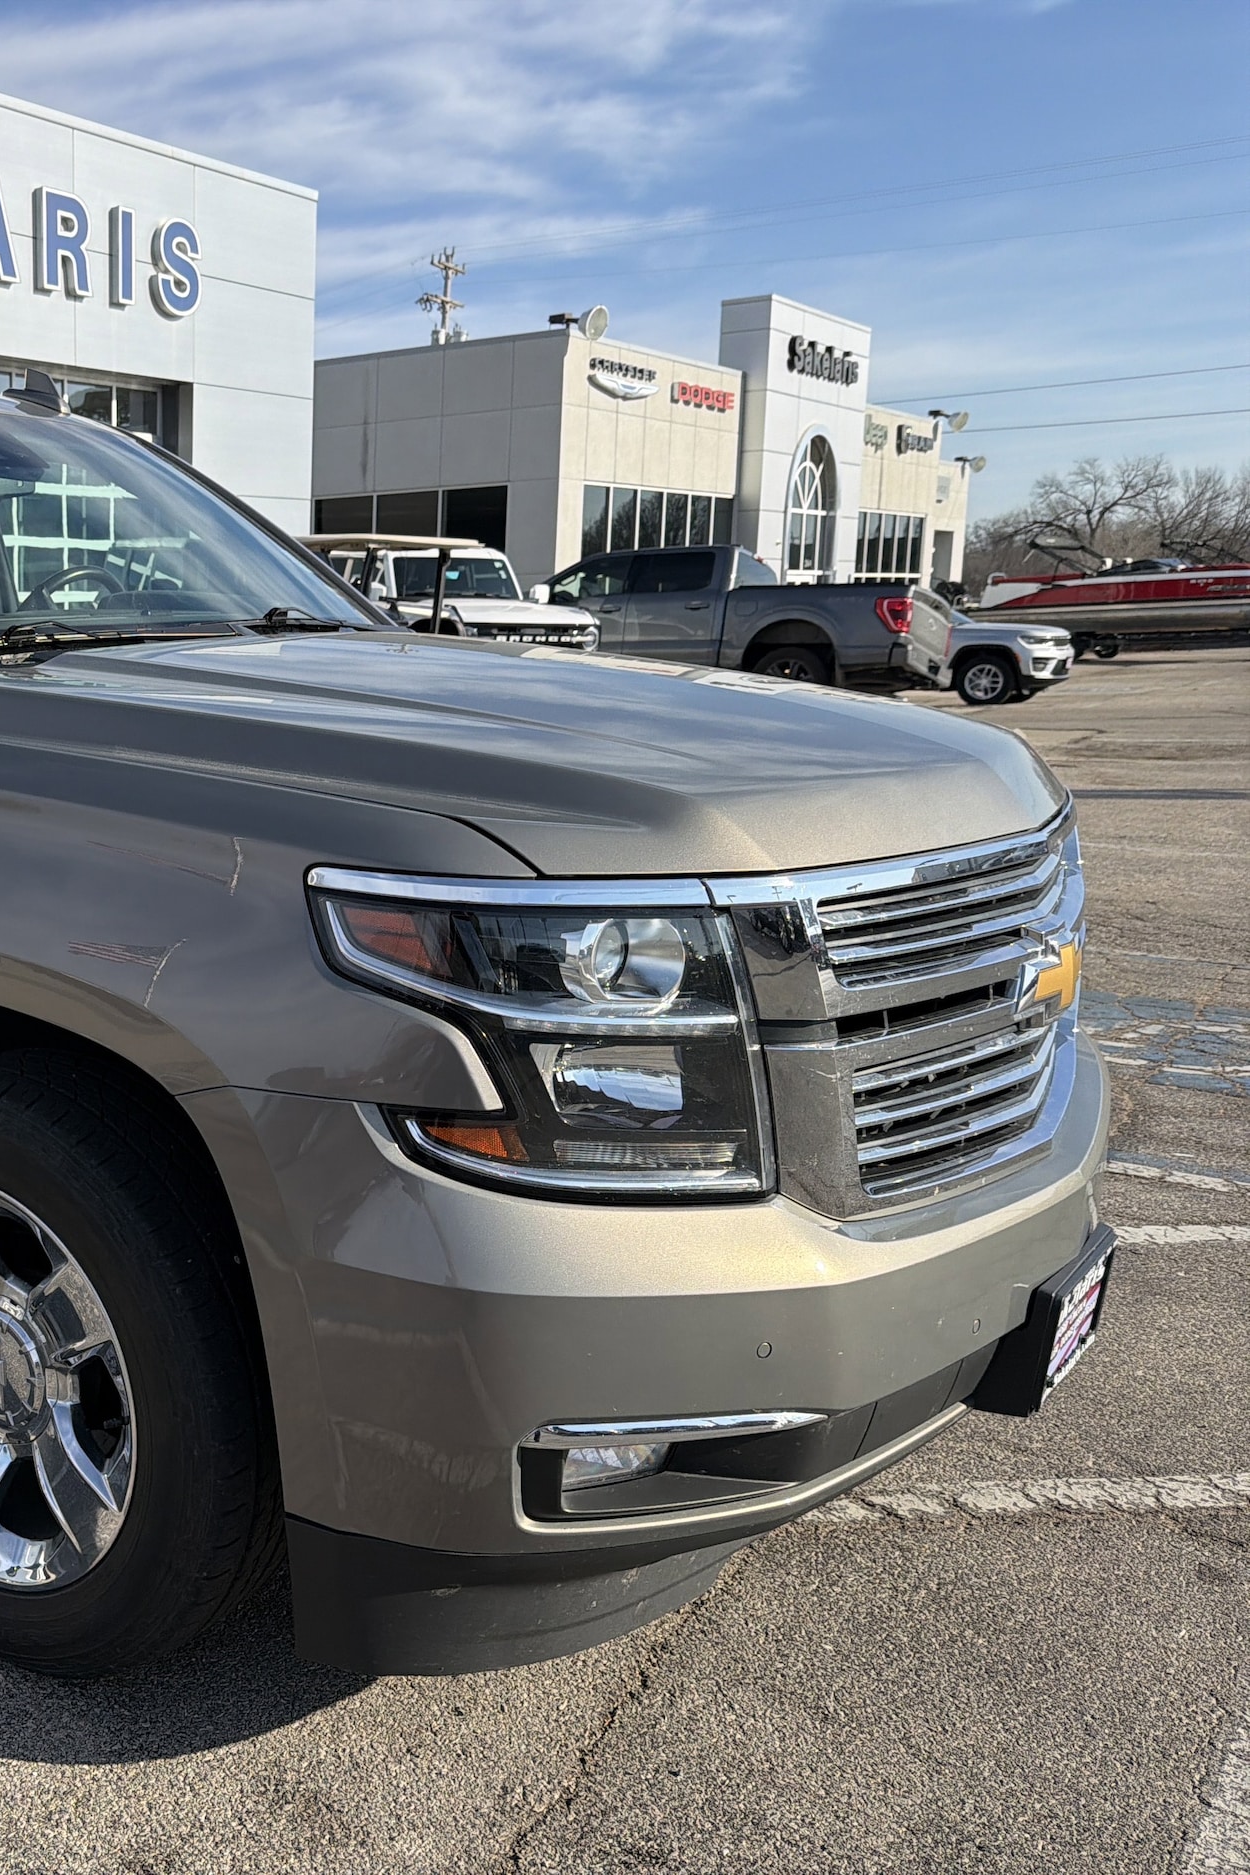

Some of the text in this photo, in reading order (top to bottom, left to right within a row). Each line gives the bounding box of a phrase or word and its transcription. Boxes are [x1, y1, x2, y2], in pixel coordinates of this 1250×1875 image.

[787, 335, 859, 387] Sakelaris
[671, 381, 735, 413] DODGE
[863, 414, 888, 453] Jeep
